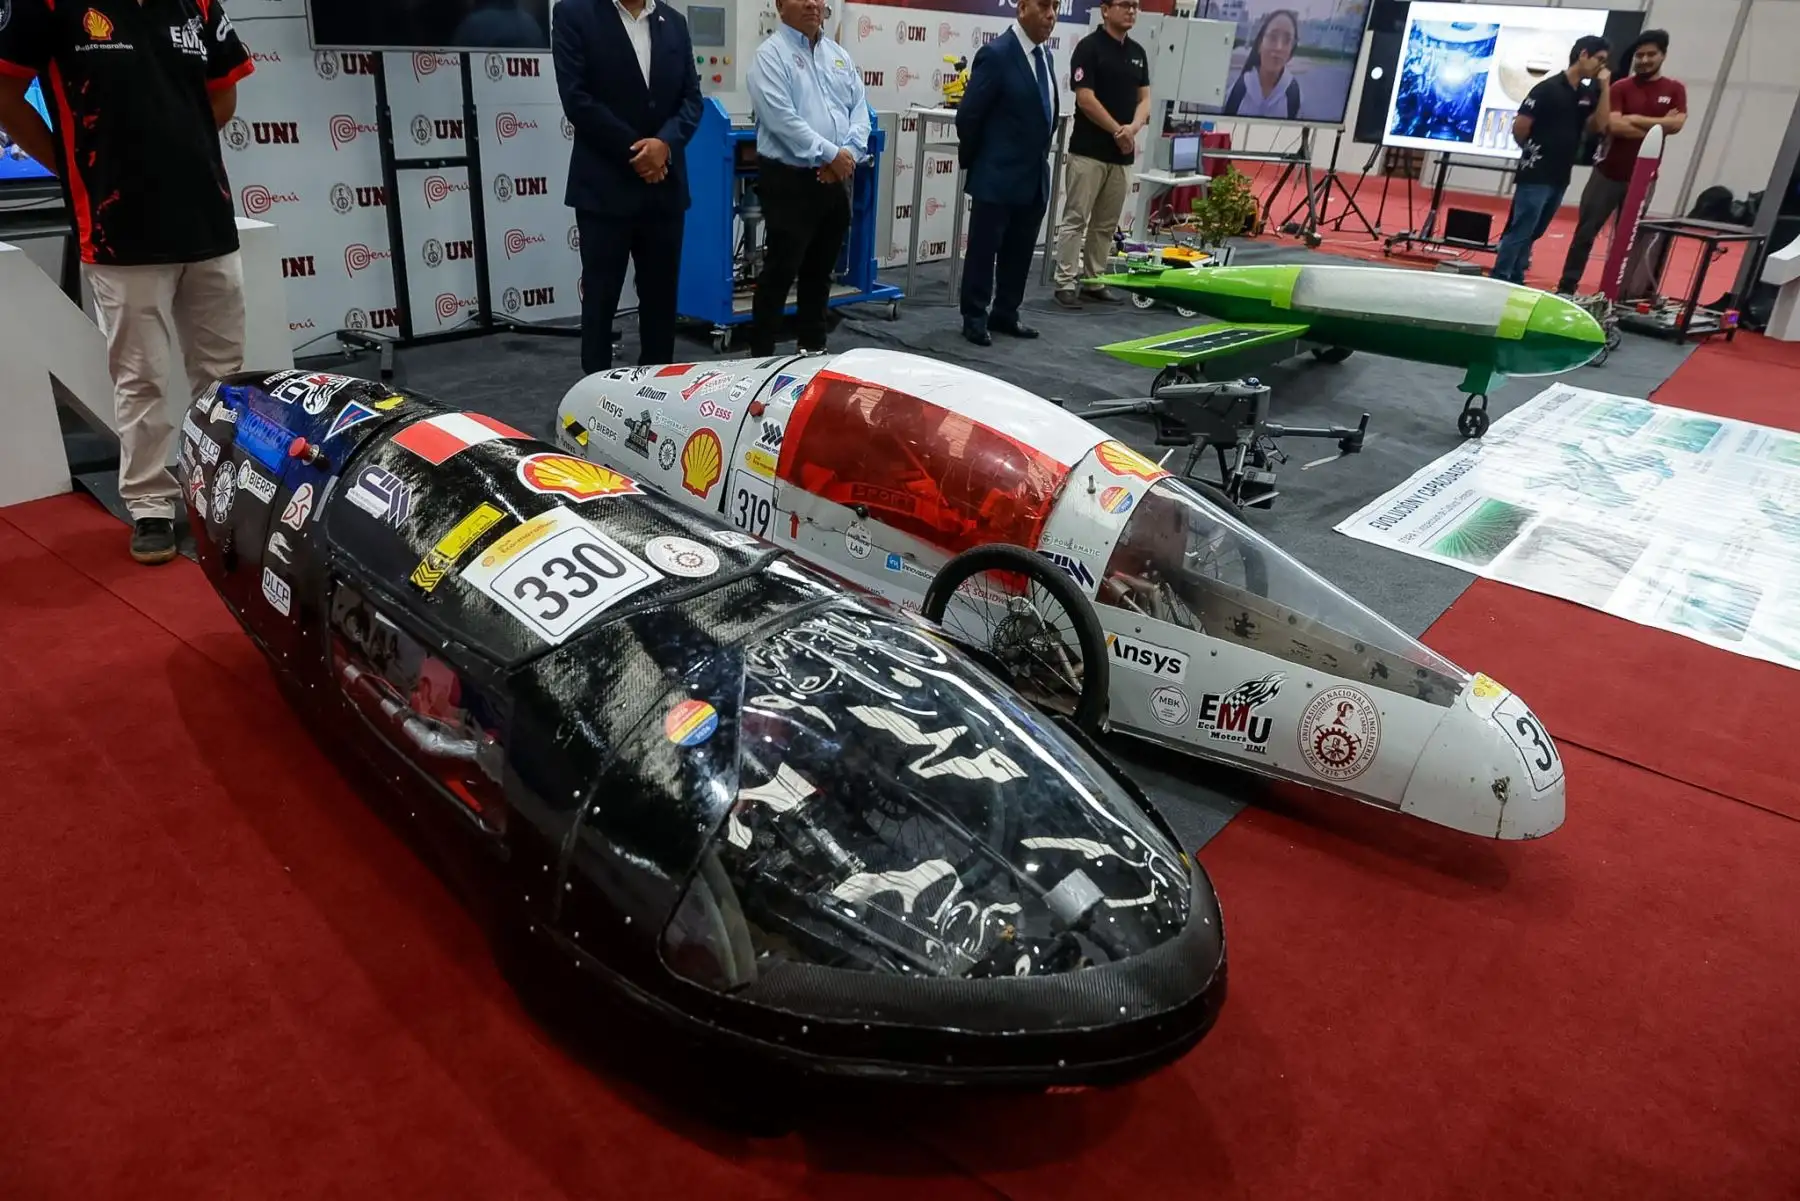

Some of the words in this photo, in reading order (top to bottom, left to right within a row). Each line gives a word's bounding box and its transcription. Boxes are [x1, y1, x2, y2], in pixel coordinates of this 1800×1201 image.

[908, 26, 926, 41] UNI
[341, 53, 374, 75] UN
[506, 57, 540, 77] UNI
[864, 71, 884, 86] UNI
[253, 122, 299, 144] UNI
[434, 120, 464, 139] UN
[901, 118, 916, 132] UN
[936, 160, 953, 174] UNI
[515, 177, 547, 196] UNI
[356, 186, 388, 207] UN
[445, 241, 473, 260] UN
[930, 241, 946, 255] UNI
[523, 287, 555, 306] UNI
[289, 319, 316, 331] erú
[370, 308, 400, 328] UN
[599, 396, 623, 418] Ansys
[249, 474, 276, 498] BIERPS
[735, 488, 770, 537] 319
[850, 542, 864, 555] LAB
[264, 571, 290, 601] DLCP
[514, 543, 626, 620] 330
[1106, 633, 1182, 674] Ansys
[1159, 695, 1180, 708] MBK
[1198, 721, 1215, 730] Eco
[1199, 694, 1273, 744] EMU
[1210, 731, 1247, 742] Motors
[1244, 744, 1267, 755] UNI
